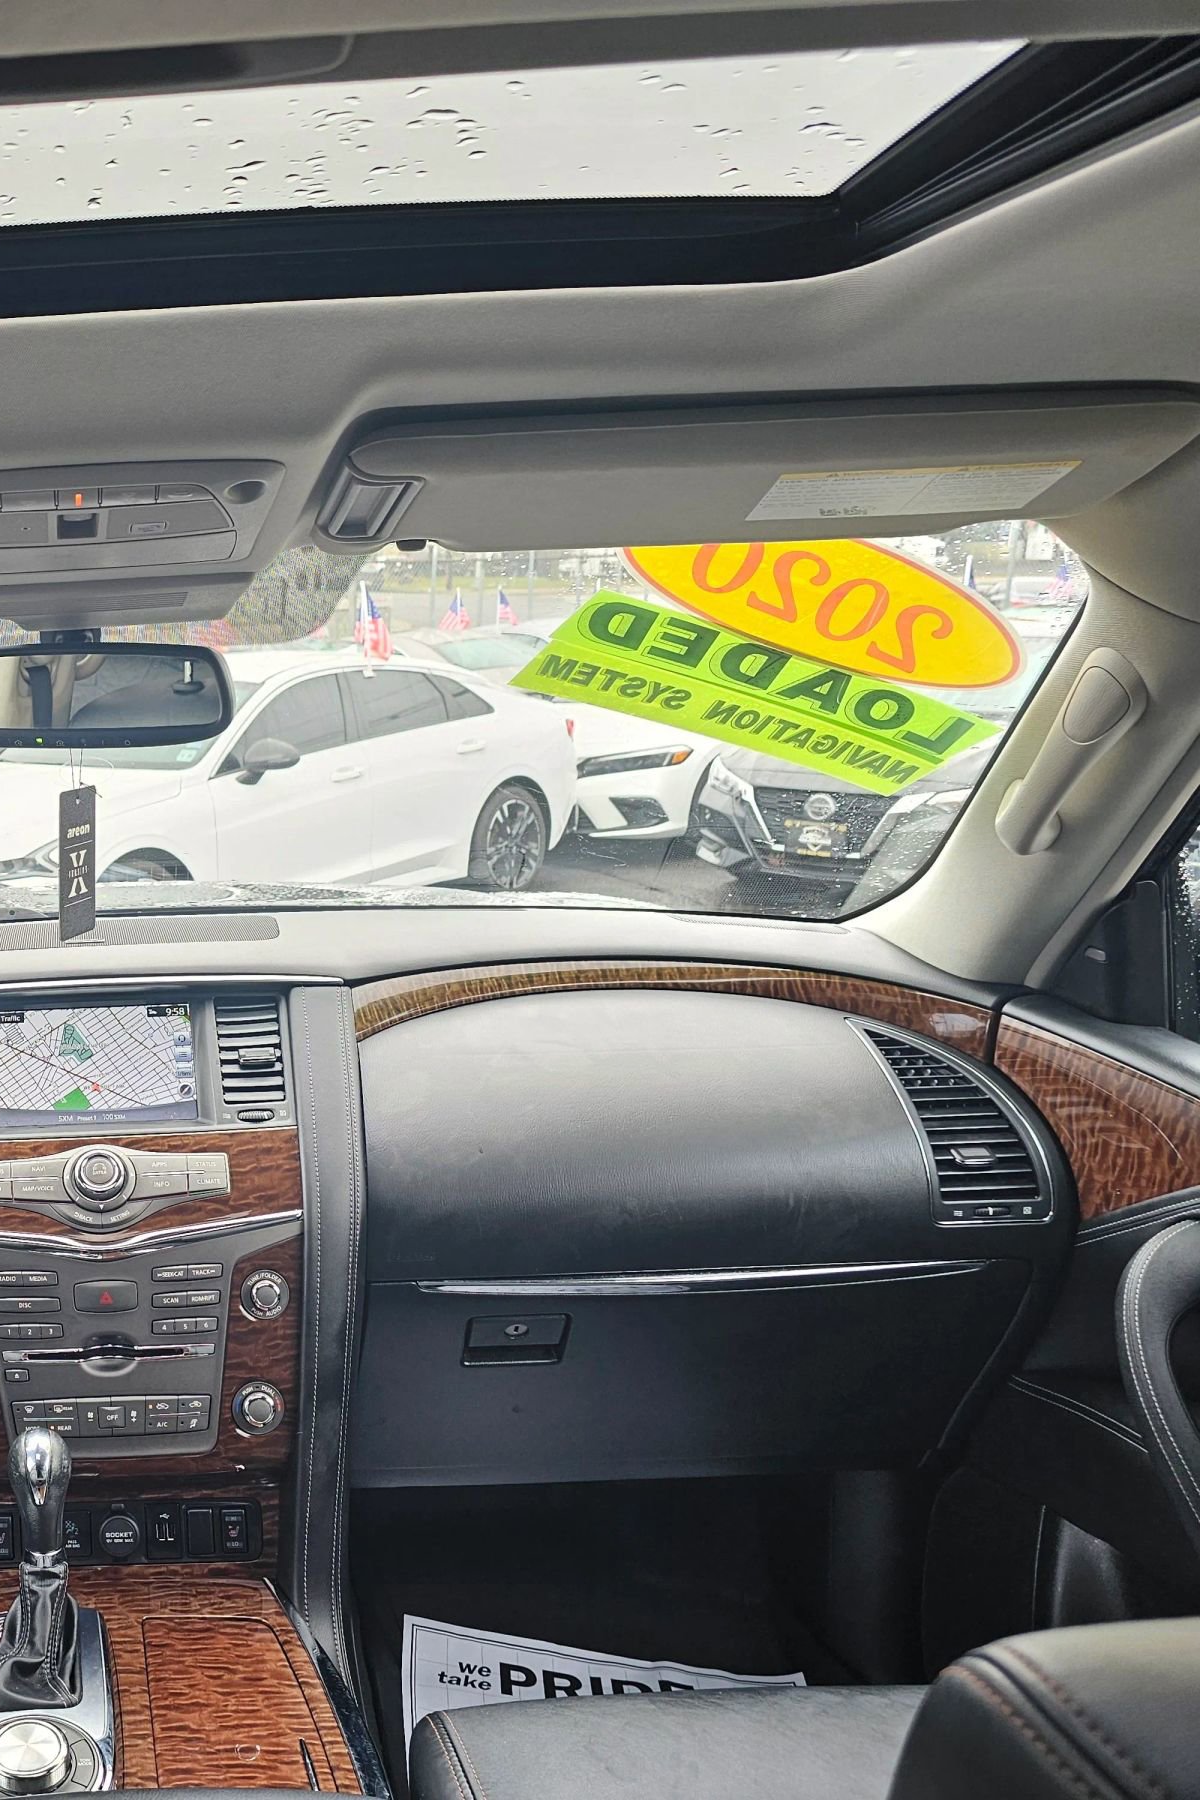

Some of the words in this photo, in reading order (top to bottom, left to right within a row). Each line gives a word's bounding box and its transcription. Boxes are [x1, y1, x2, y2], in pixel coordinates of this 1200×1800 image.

[66, 823, 90, 839] areon
[165, 1007, 185, 1016] 9:58
[0, 1014, 21, 1023] Traffic
[266, 1306, 282, 1317] AUDIO
[261, 1385, 276, 1397] DUAL
[106, 1414, 119, 1422] OFF
[458, 1661, 492, 1677] we
[438, 1671, 492, 1691] take
[499, 1661, 695, 1700] PRI
